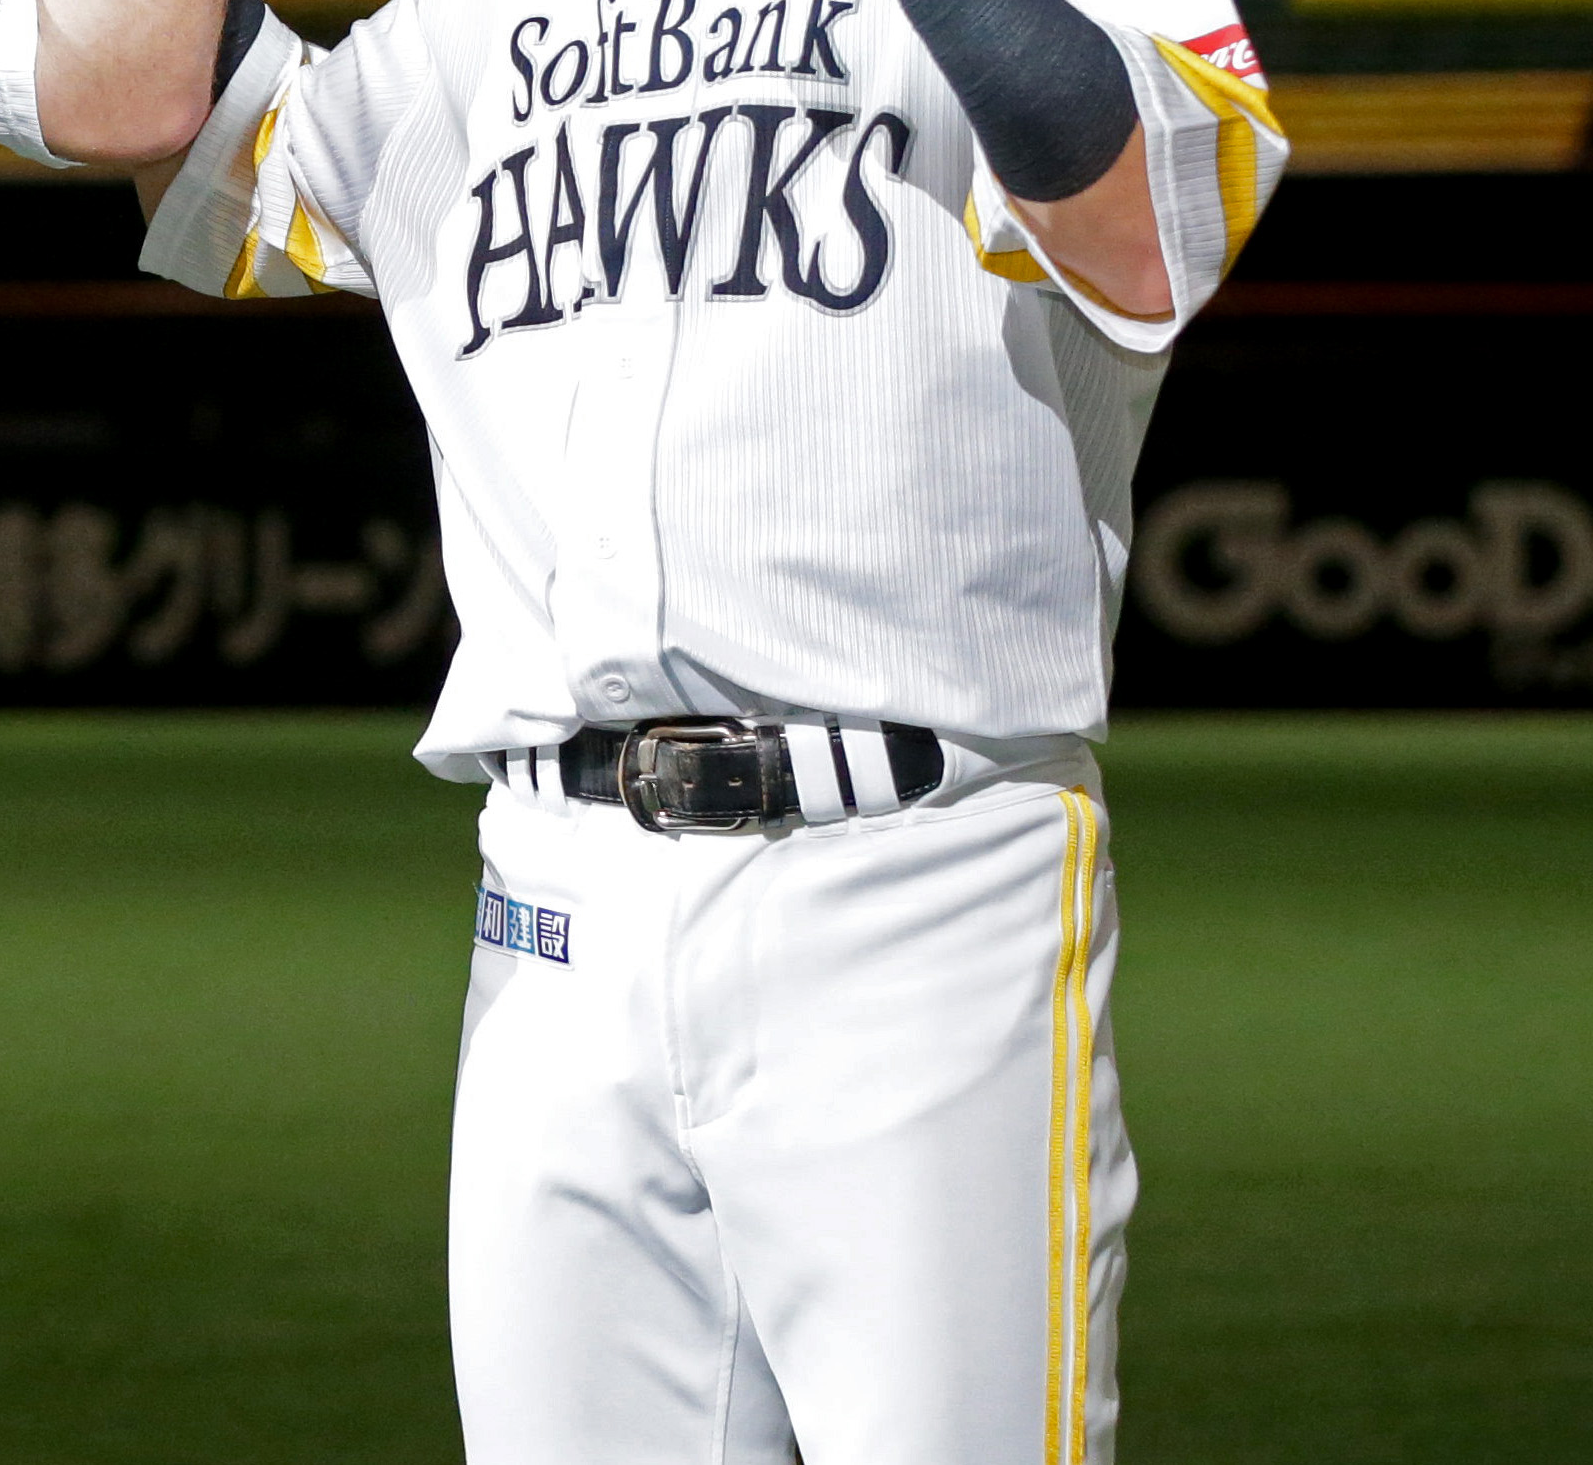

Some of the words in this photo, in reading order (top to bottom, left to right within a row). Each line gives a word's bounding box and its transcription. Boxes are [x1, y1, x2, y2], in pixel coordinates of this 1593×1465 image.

[455, 97, 917, 360] HAWKS
[475, 888, 567, 961] 和建設
